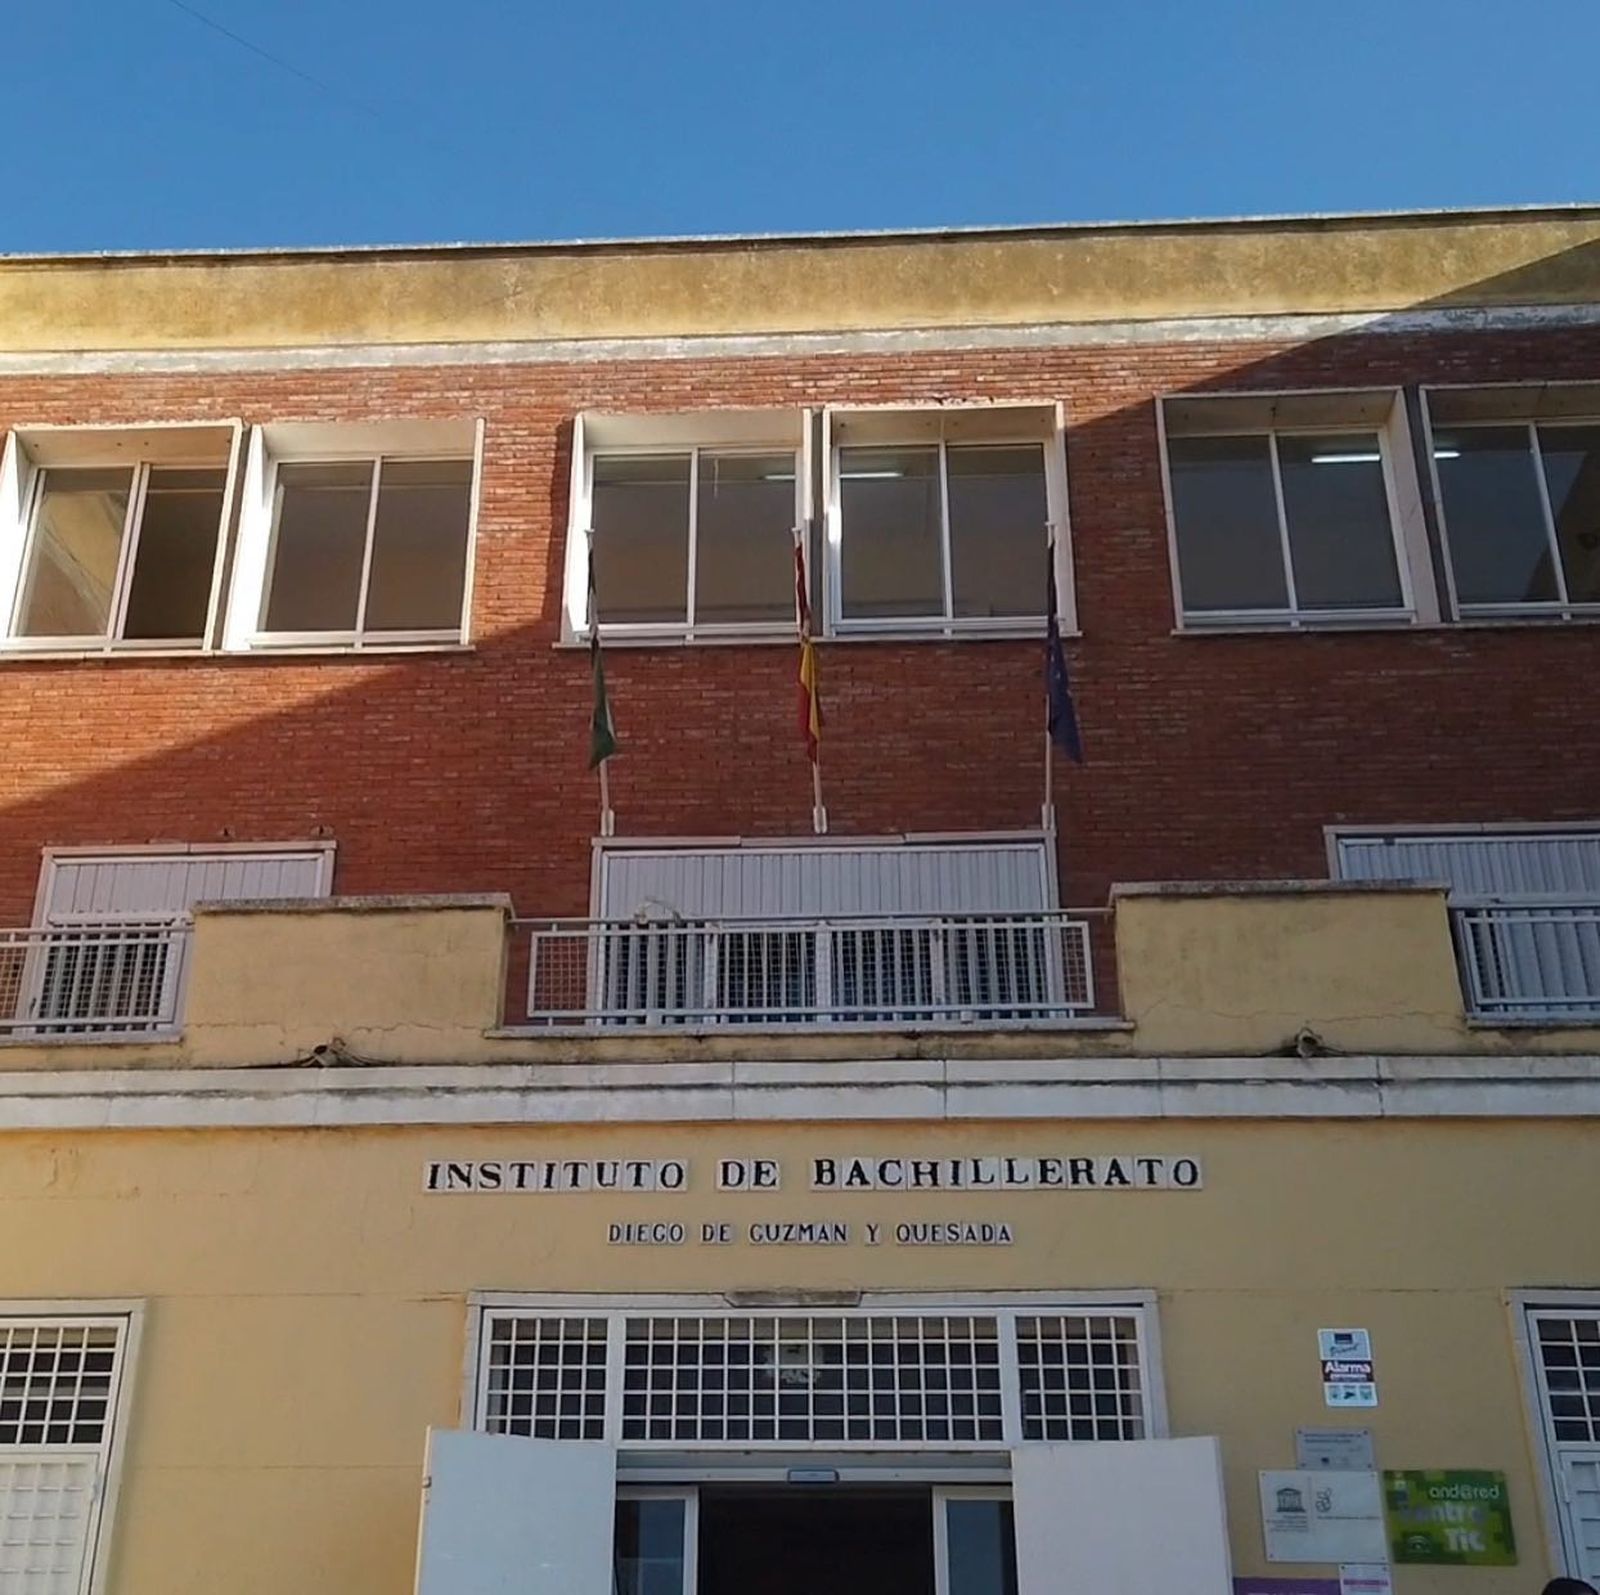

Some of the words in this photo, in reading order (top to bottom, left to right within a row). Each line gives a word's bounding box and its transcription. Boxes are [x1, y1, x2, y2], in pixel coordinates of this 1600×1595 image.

[427, 1161, 684, 1190] INSTITUTO
[721, 1160, 777, 1187] DE
[813, 1157, 1200, 1186] BACHILLERATO
[609, 1223, 684, 1243] DIEGO
[702, 1223, 731, 1242] DE
[749, 1223, 847, 1243] GUZMAN
[866, 1224, 879, 1242] Y
[896, 1222, 1011, 1243] QUESADA
[1325, 1361, 1371, 1374] Alarma
[1400, 1501, 1485, 1523] ntro
